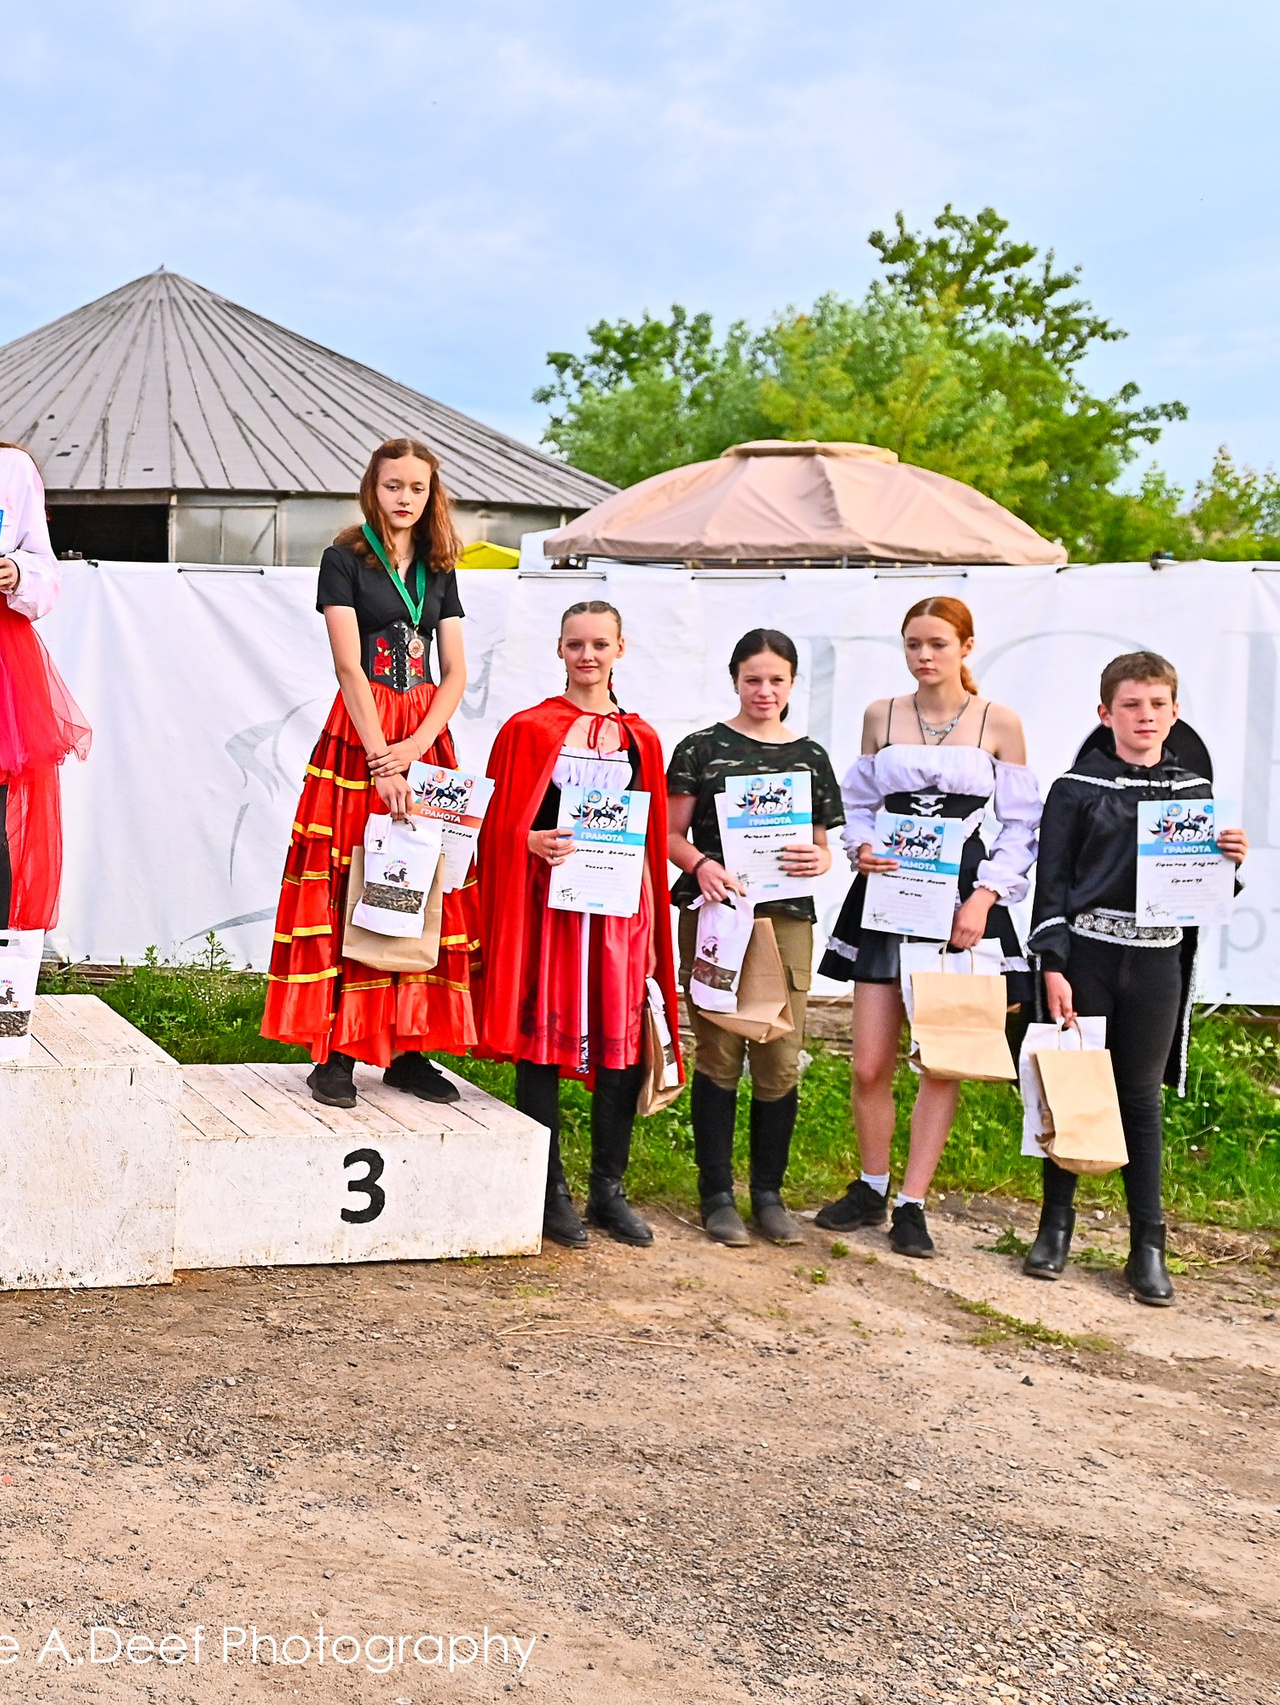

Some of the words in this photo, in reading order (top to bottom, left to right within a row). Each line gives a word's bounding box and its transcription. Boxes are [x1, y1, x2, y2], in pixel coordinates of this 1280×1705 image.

[420, 808, 462, 824] ГРАМОТА
[748, 816, 792, 827] ГРАМОТА
[580, 831, 624, 843] ГРАМОТА
[1163, 845, 1212, 854] ГРАМОТА
[340, 1148, 386, 1224] 3
